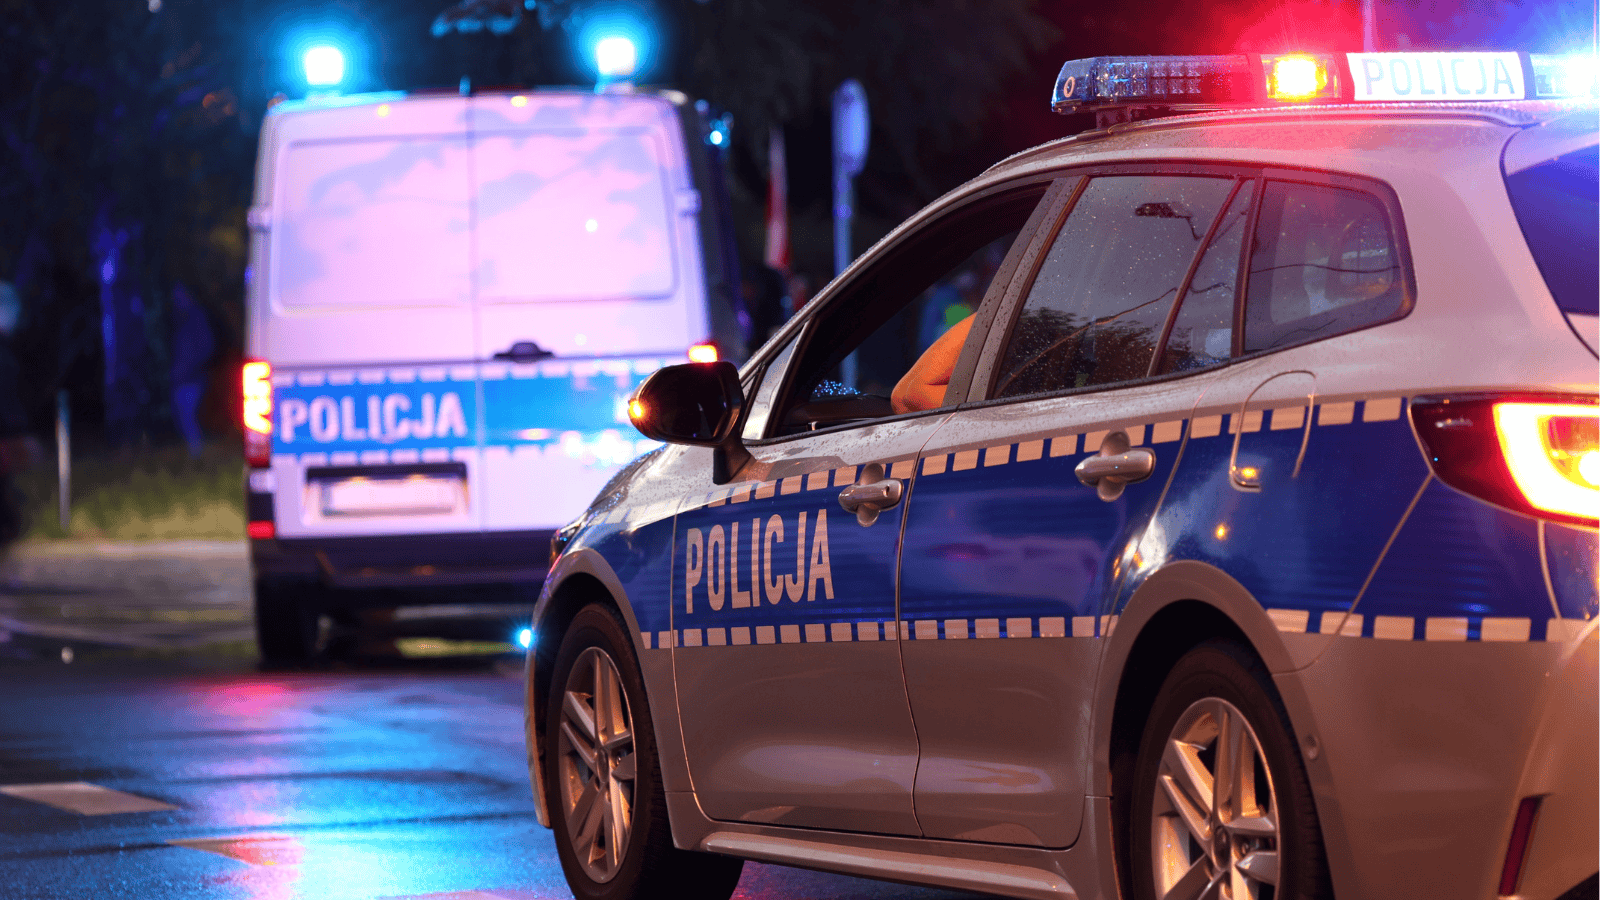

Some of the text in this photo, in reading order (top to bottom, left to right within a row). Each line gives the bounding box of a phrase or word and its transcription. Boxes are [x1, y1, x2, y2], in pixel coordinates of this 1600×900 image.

[1361, 58, 1515, 95] POLICJA
[280, 392, 468, 443] POLICJA
[686, 508, 834, 614] POLICJA
